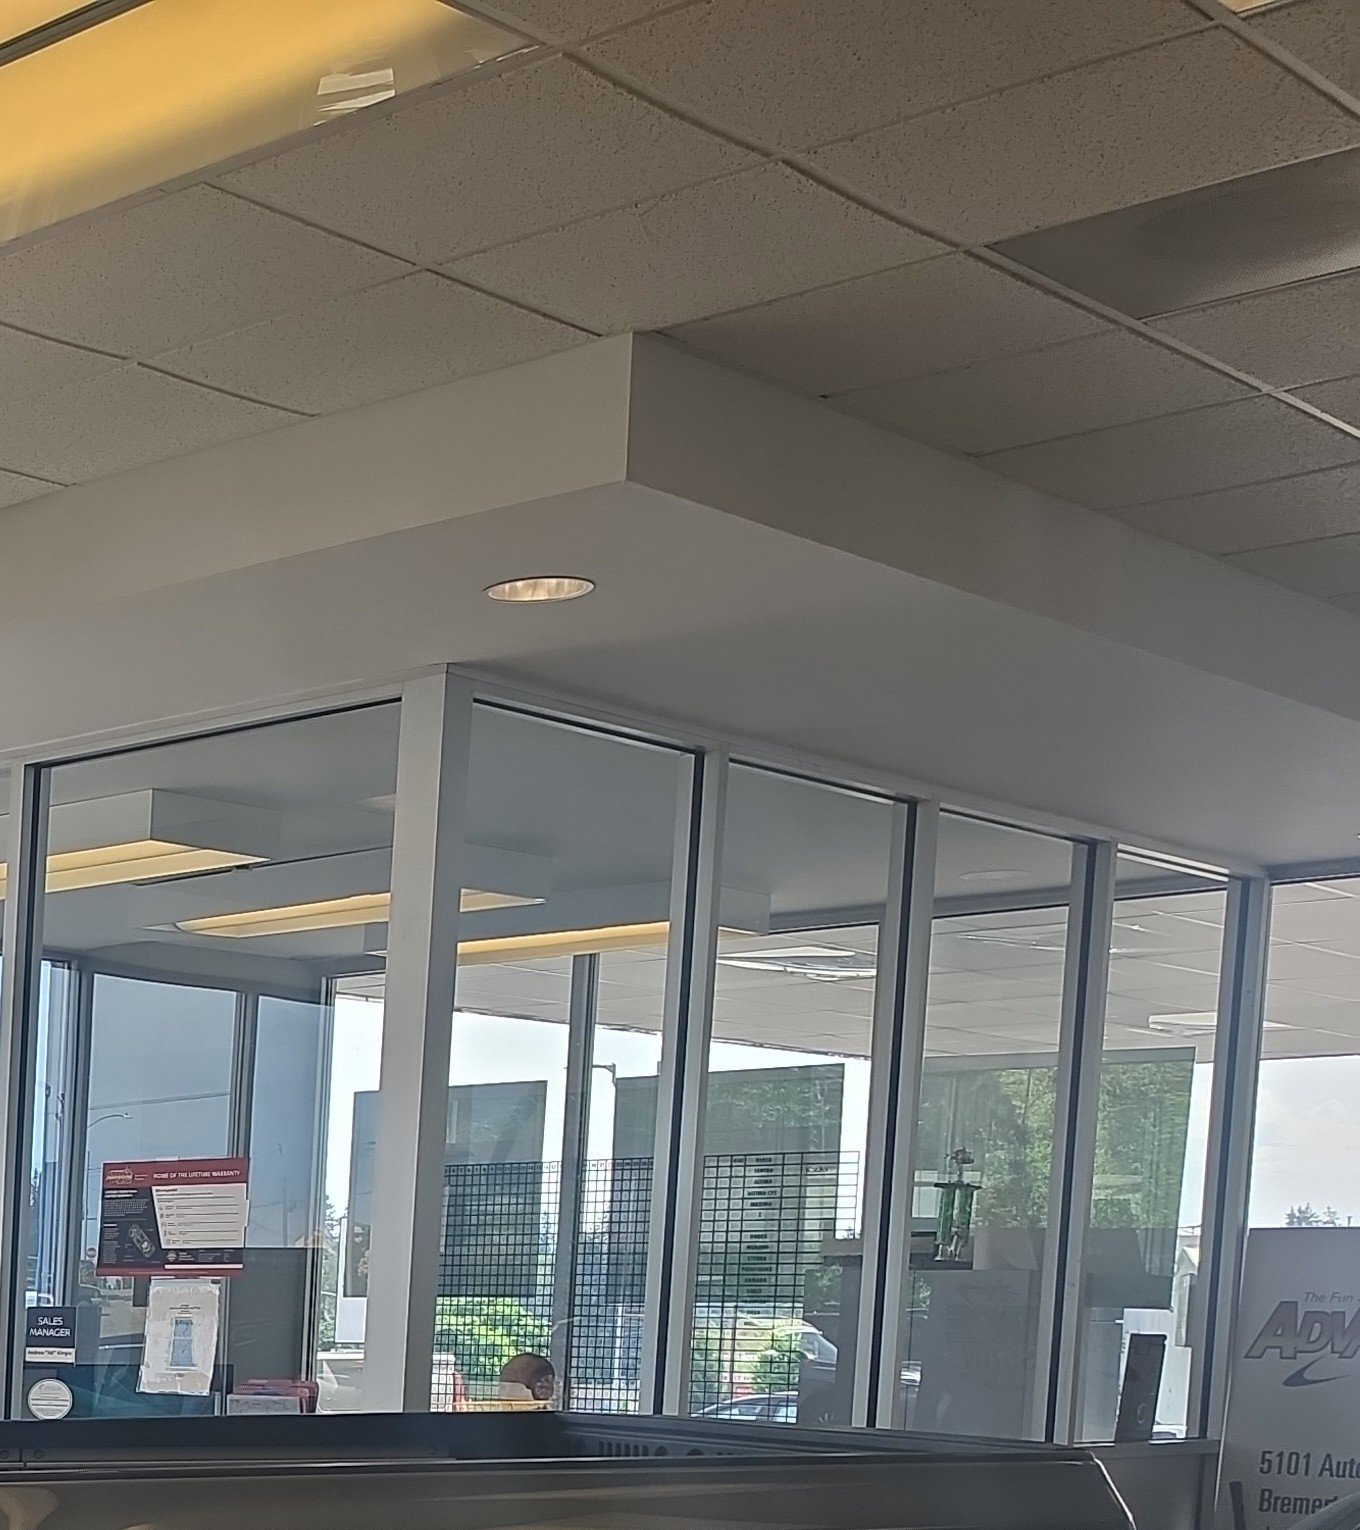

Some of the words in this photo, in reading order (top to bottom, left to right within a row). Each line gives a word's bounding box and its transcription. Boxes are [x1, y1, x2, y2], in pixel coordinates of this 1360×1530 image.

[37, 1316, 64, 1326] SALES
[29, 1327, 71, 1337] MANAGER
[1259, 1450, 1312, 1477] 5101
